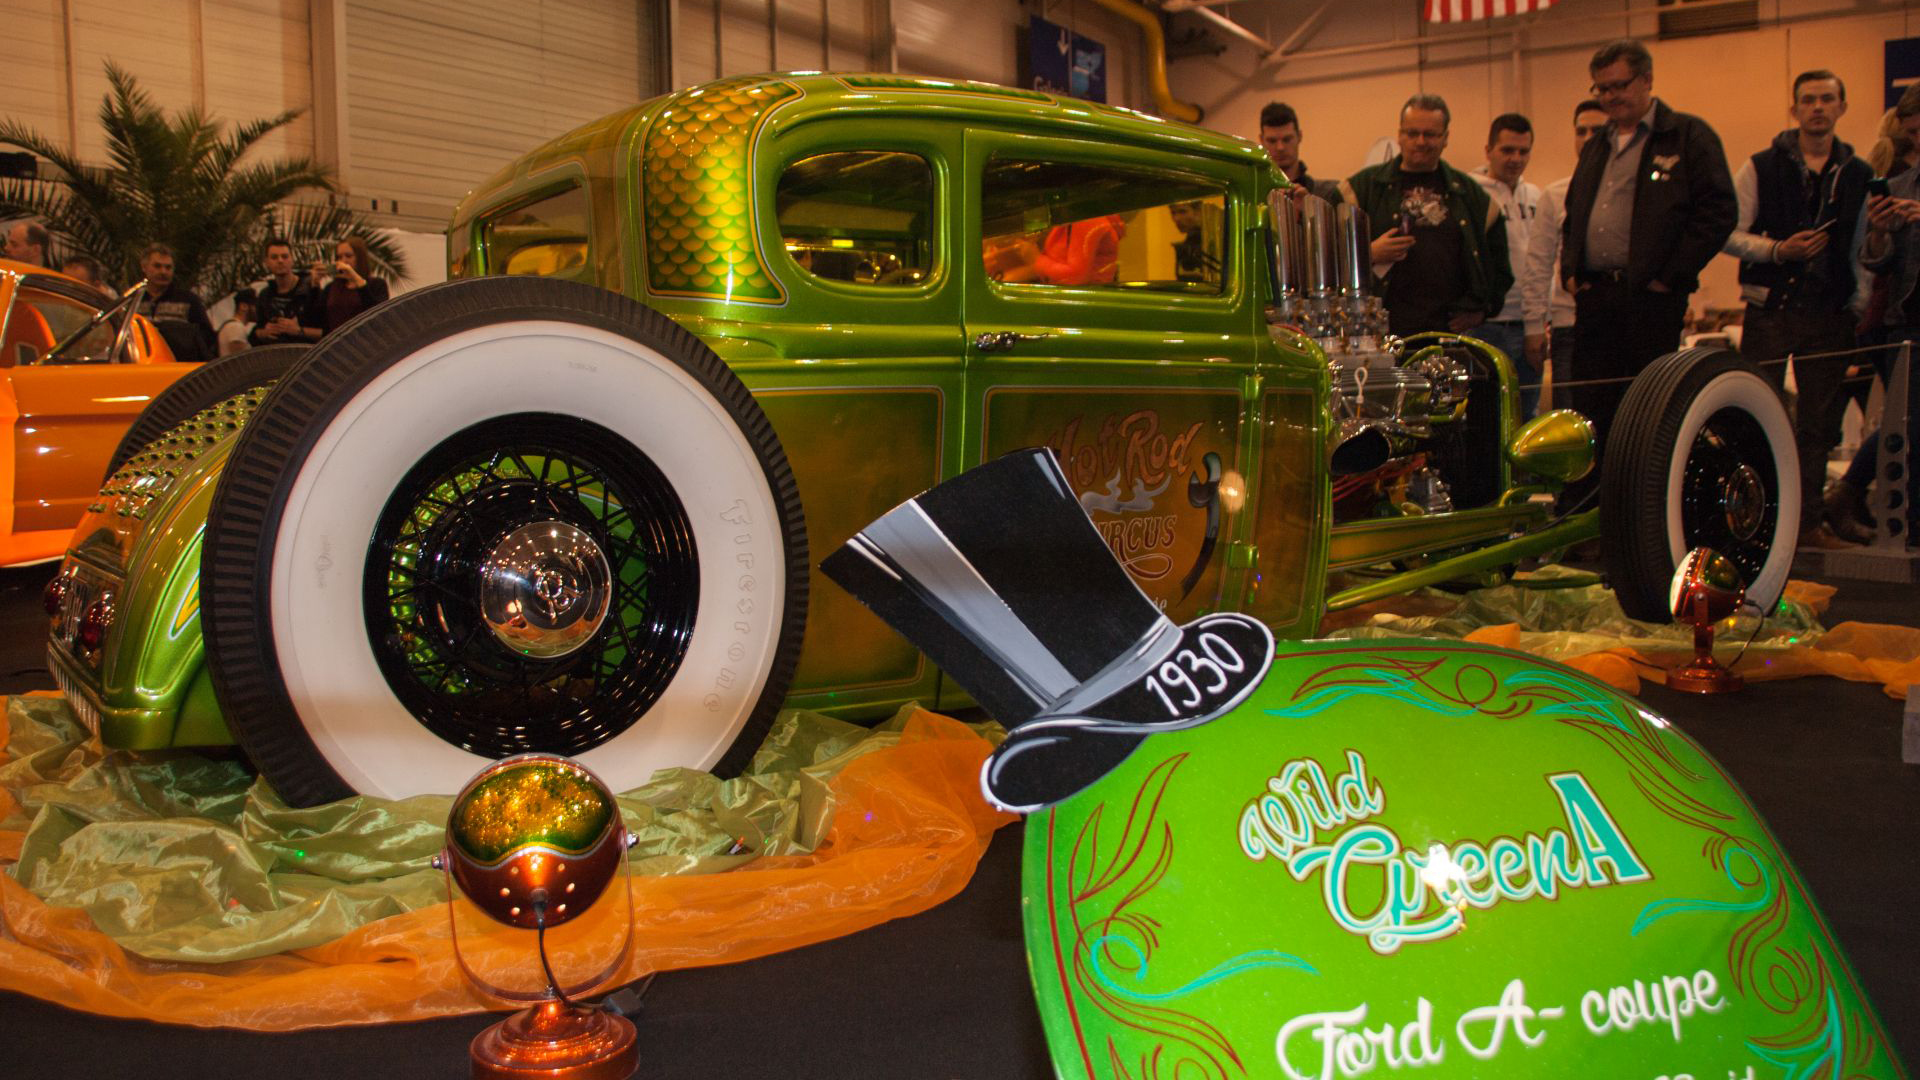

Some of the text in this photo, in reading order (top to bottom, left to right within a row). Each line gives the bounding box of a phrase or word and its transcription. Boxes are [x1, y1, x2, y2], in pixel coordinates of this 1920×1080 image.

[1118, 409, 1206, 490] Rod
[1096, 514, 1178, 580] IRCUS
[703, 498, 756, 713] Firestone
[1146, 632, 1245, 717] 1930
[1237, 748, 1386, 862] Wild
[1275, 996, 1445, 1080] Ford
[1580, 968, 1724, 1042] coupe
